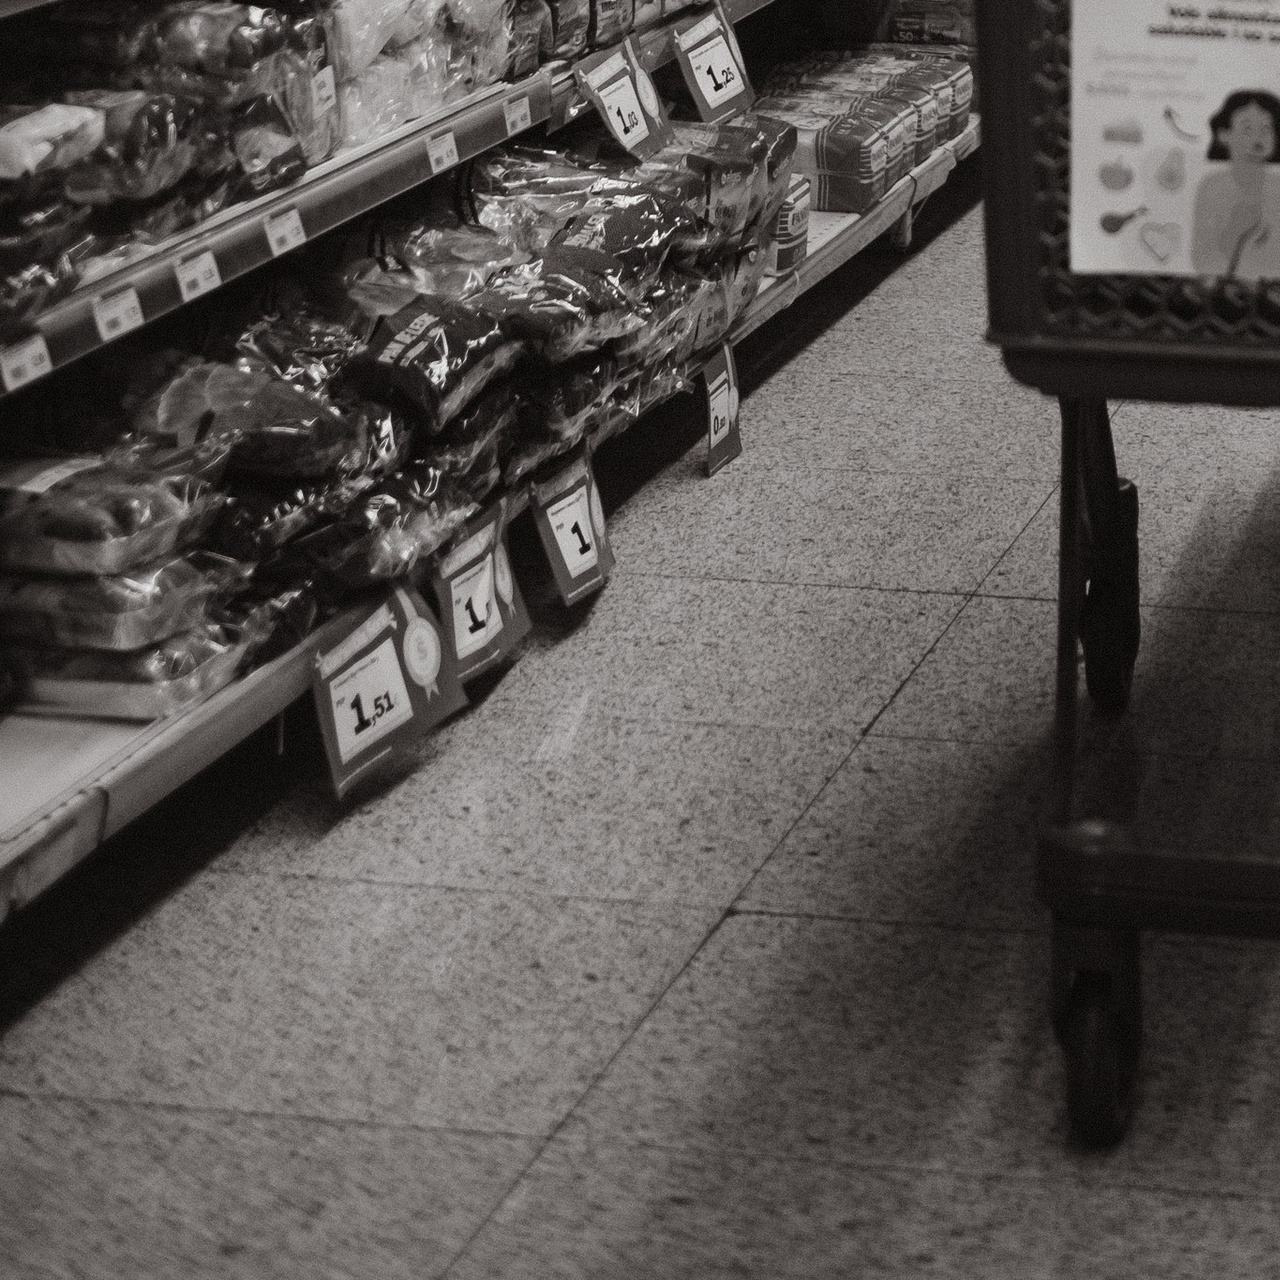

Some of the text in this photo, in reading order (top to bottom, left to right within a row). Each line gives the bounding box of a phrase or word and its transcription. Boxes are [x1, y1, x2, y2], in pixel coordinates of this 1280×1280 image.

[706, 64, 735, 93] 1,25
[616, 106, 638, 136] 1,03
[350, 689, 395, 736] 1,51
